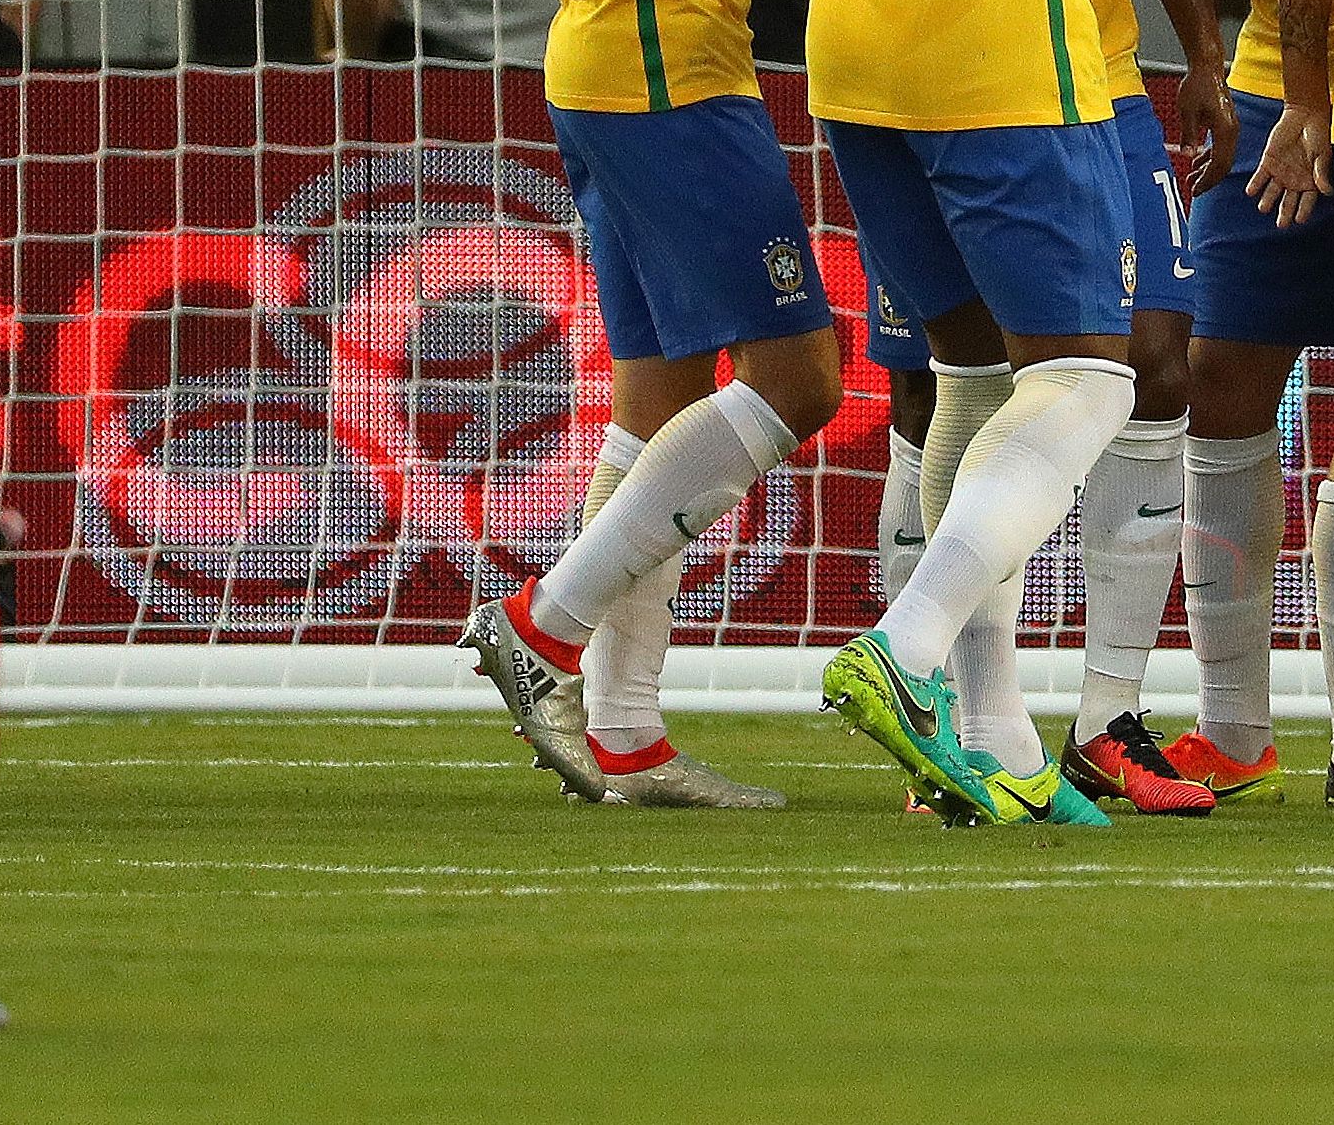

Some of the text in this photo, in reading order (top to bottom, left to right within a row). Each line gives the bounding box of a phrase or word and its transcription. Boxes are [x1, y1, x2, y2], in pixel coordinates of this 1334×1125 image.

[776, 290, 809, 306] BRASIL
[879, 326, 912, 338] BRASIL
[511, 649, 534, 717] adidas
